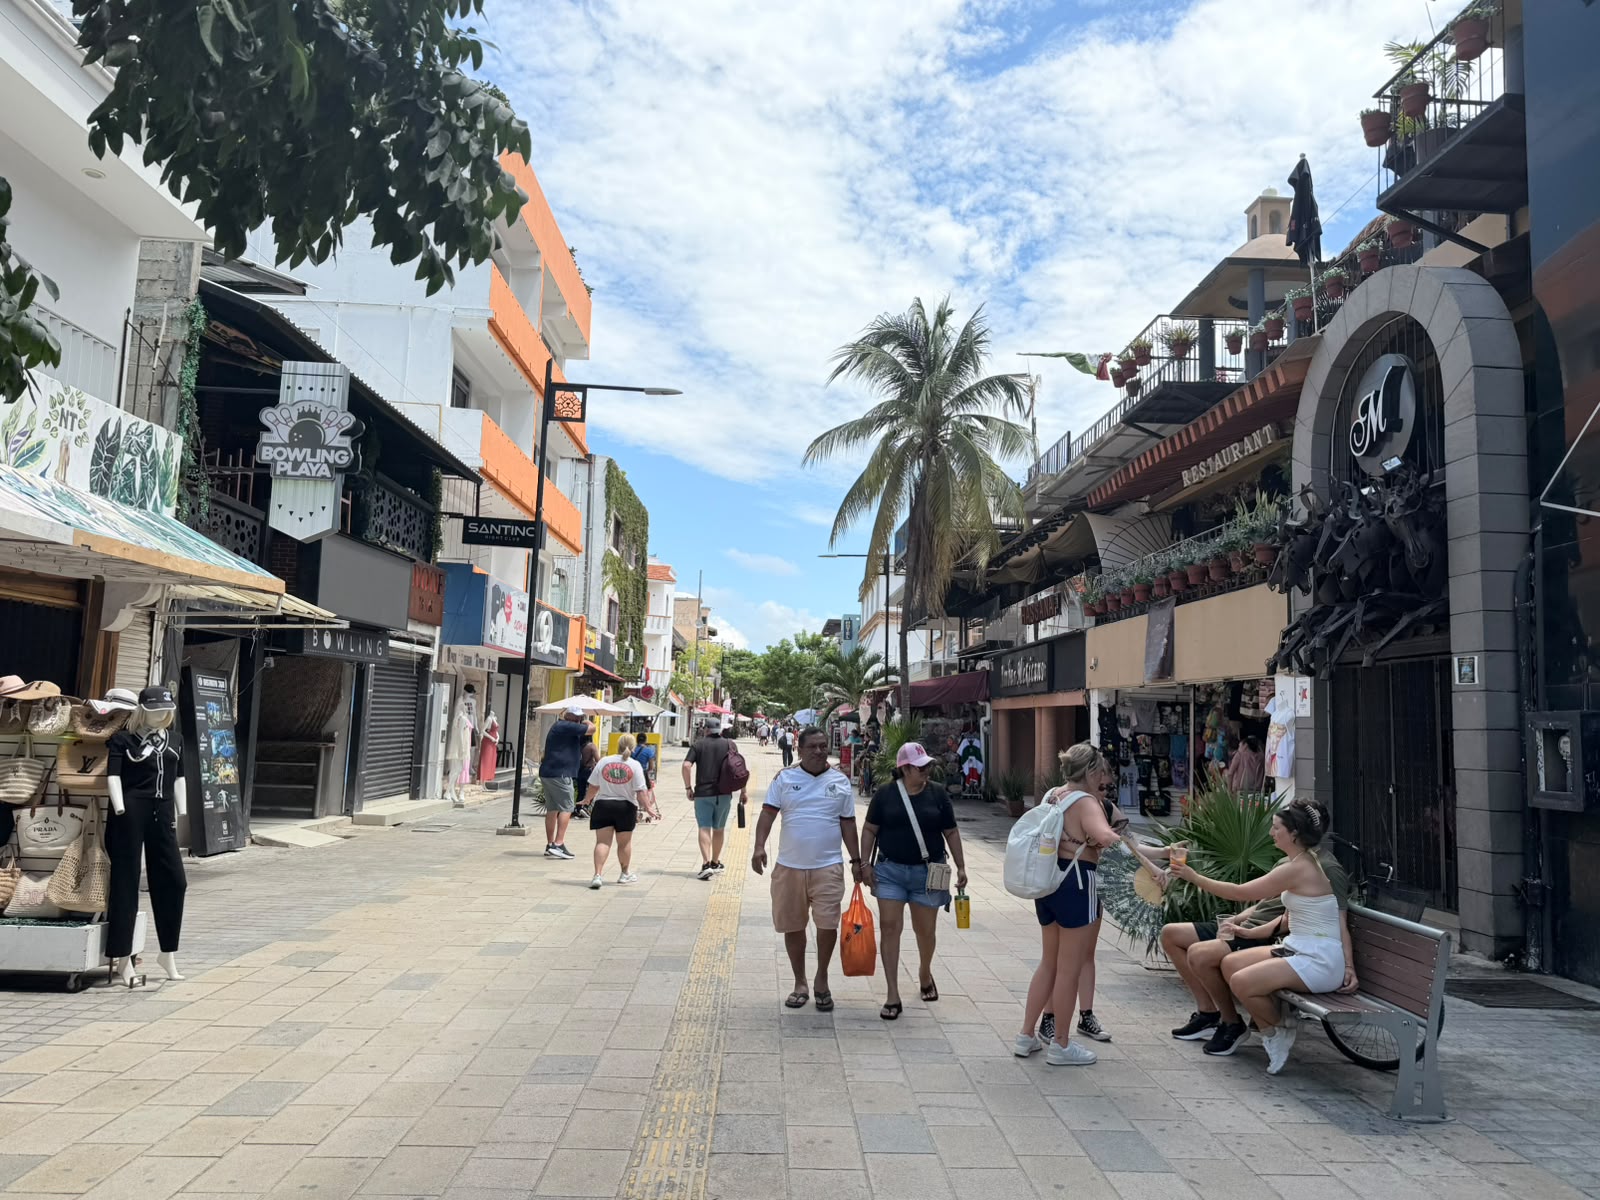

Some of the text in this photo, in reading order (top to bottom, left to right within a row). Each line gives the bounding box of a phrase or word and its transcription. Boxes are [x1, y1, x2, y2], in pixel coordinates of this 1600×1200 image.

[59, 407, 78, 432] NT
[1350, 366, 1392, 456] M
[261, 446, 350, 465] BOWLING
[1181, 424, 1272, 488] RESTAURANT
[275, 461, 332, 478] PLAYA
[312, 628, 383, 656] BOWLING
